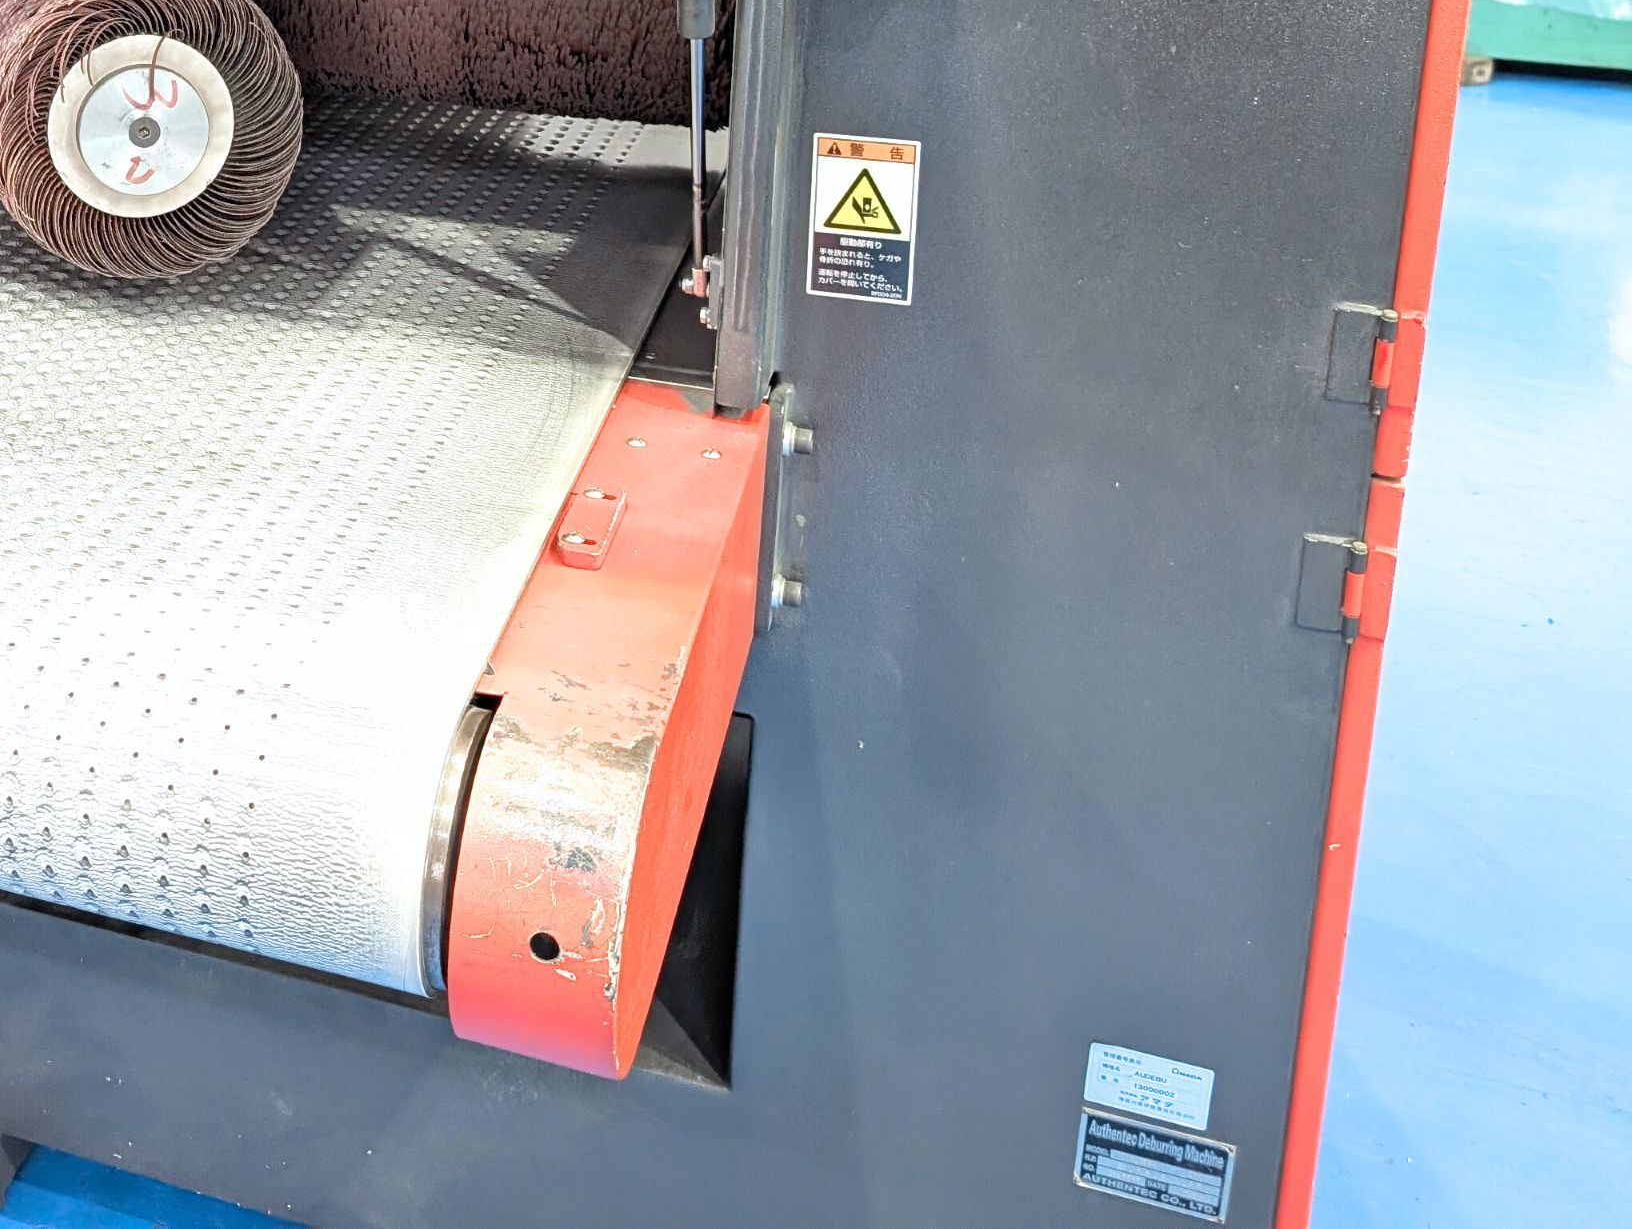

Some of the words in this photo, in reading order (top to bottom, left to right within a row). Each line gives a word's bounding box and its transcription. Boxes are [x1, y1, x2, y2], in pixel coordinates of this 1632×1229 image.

[1088, 1119, 1137, 1147] Authentec
[1137, 1132, 1184, 1161] Deburring
[1184, 1144, 1225, 1170] Machine
[1082, 1173, 1158, 1199] AUTHENTEC
